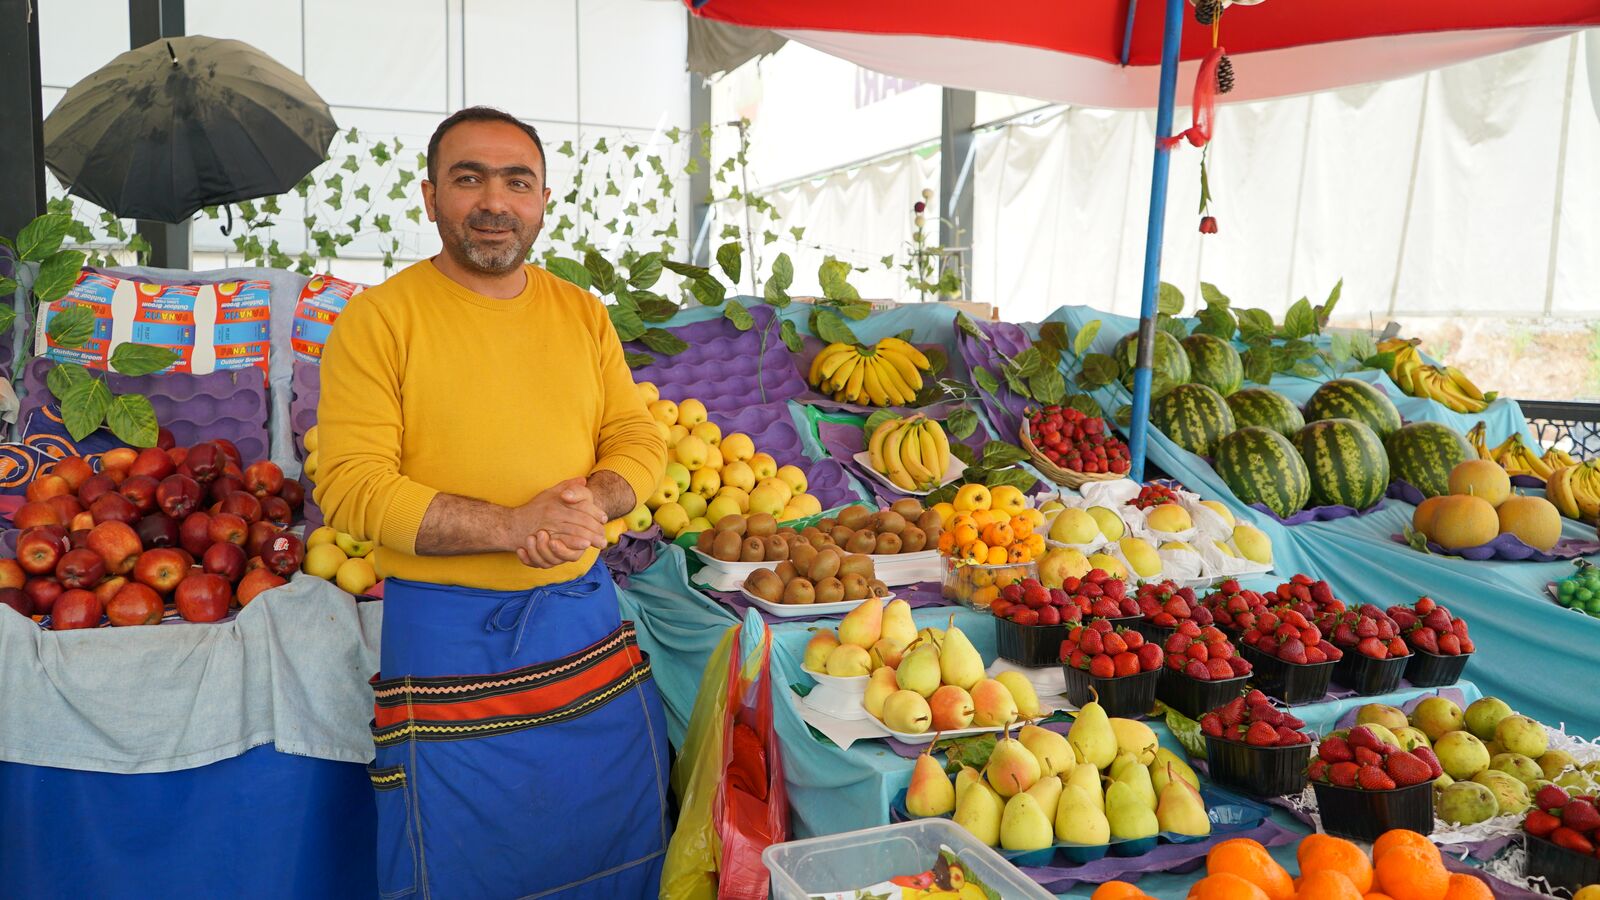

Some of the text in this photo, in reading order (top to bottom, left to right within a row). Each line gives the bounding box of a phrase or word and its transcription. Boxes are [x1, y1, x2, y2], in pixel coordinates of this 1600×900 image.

[162, 303, 189, 311] Outdoor
[241, 299, 264, 307] Outdoor
[53, 348, 80, 357] Outdoor
[220, 358, 244, 366] Outdoor
